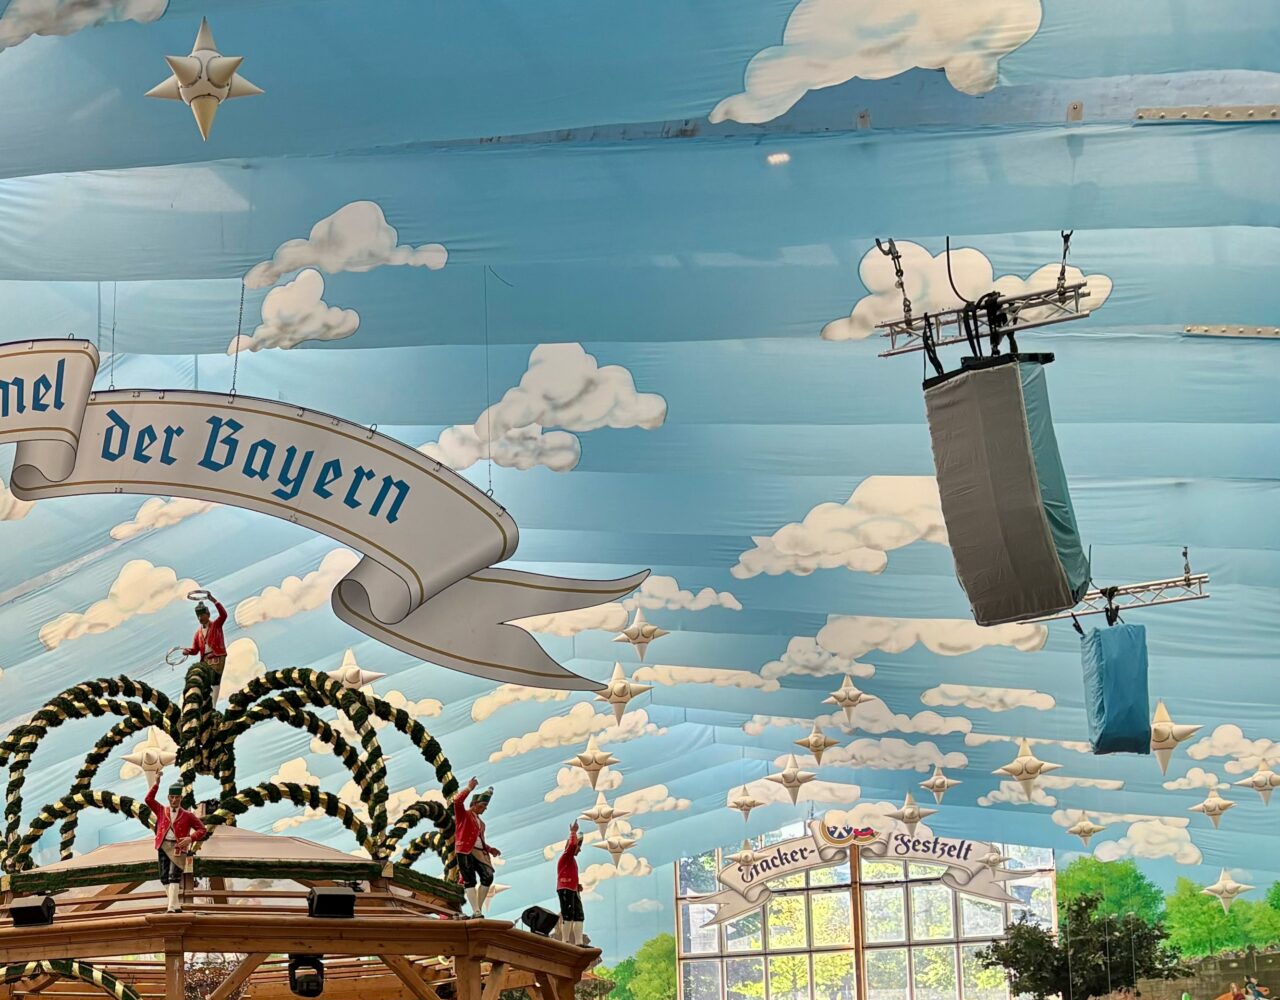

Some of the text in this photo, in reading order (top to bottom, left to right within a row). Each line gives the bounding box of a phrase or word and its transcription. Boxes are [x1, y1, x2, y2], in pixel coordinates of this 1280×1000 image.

[100, 408, 411, 525] der Bayern
[894, 833, 973, 861] Festzelt
